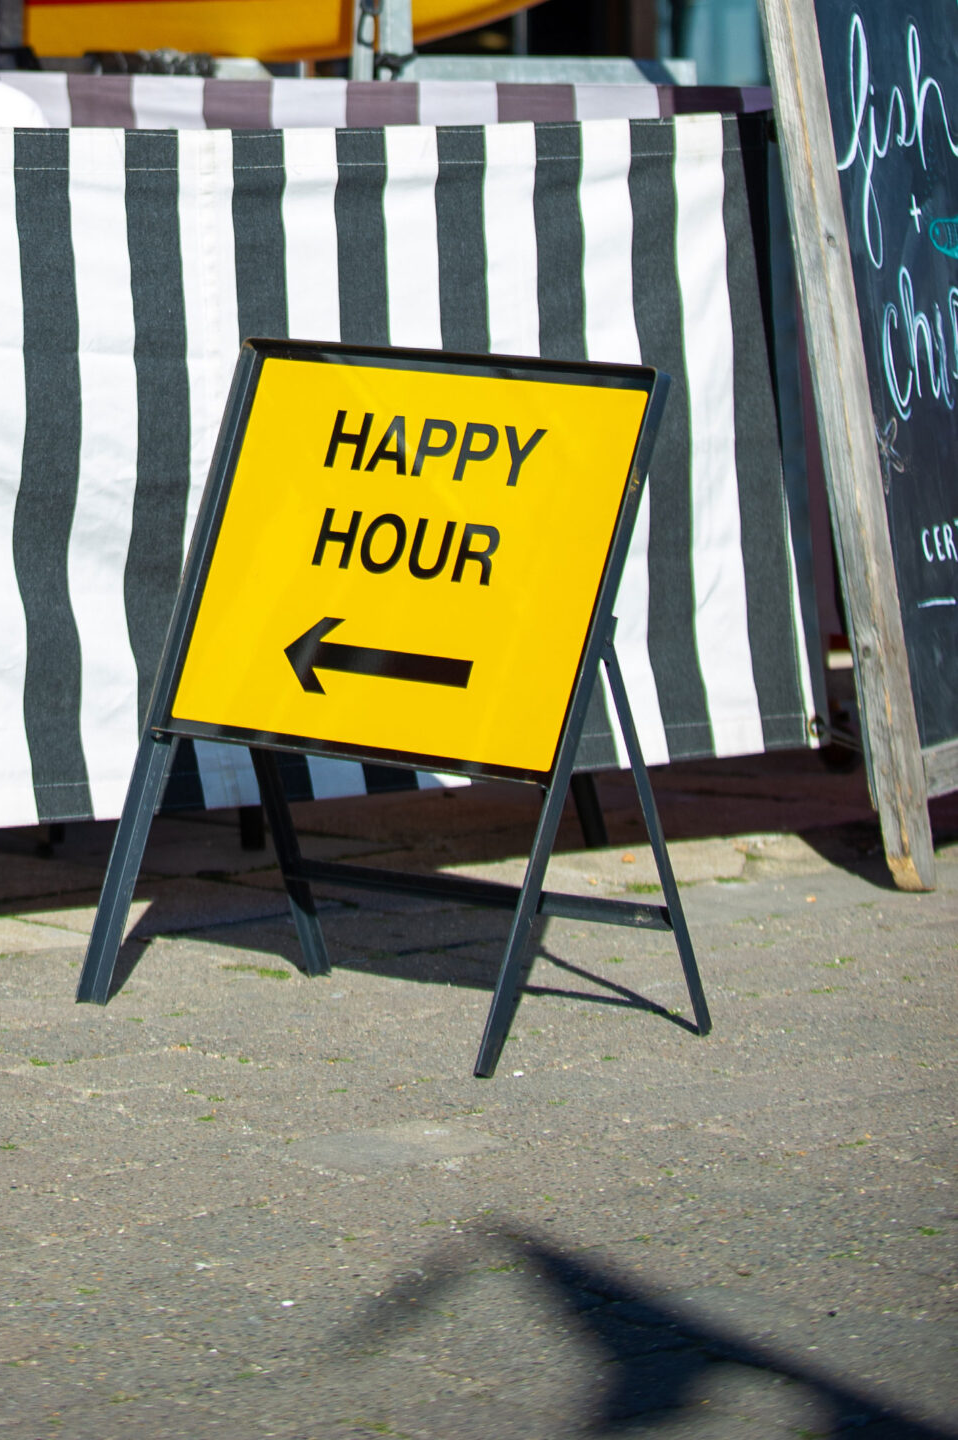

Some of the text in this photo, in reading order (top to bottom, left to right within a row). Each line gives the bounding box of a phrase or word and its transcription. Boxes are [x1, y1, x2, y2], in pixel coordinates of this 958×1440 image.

[324, 410, 547, 487] HAPPY
[311, 508, 501, 586] HOUR
[921, 518, 958, 562] CER
